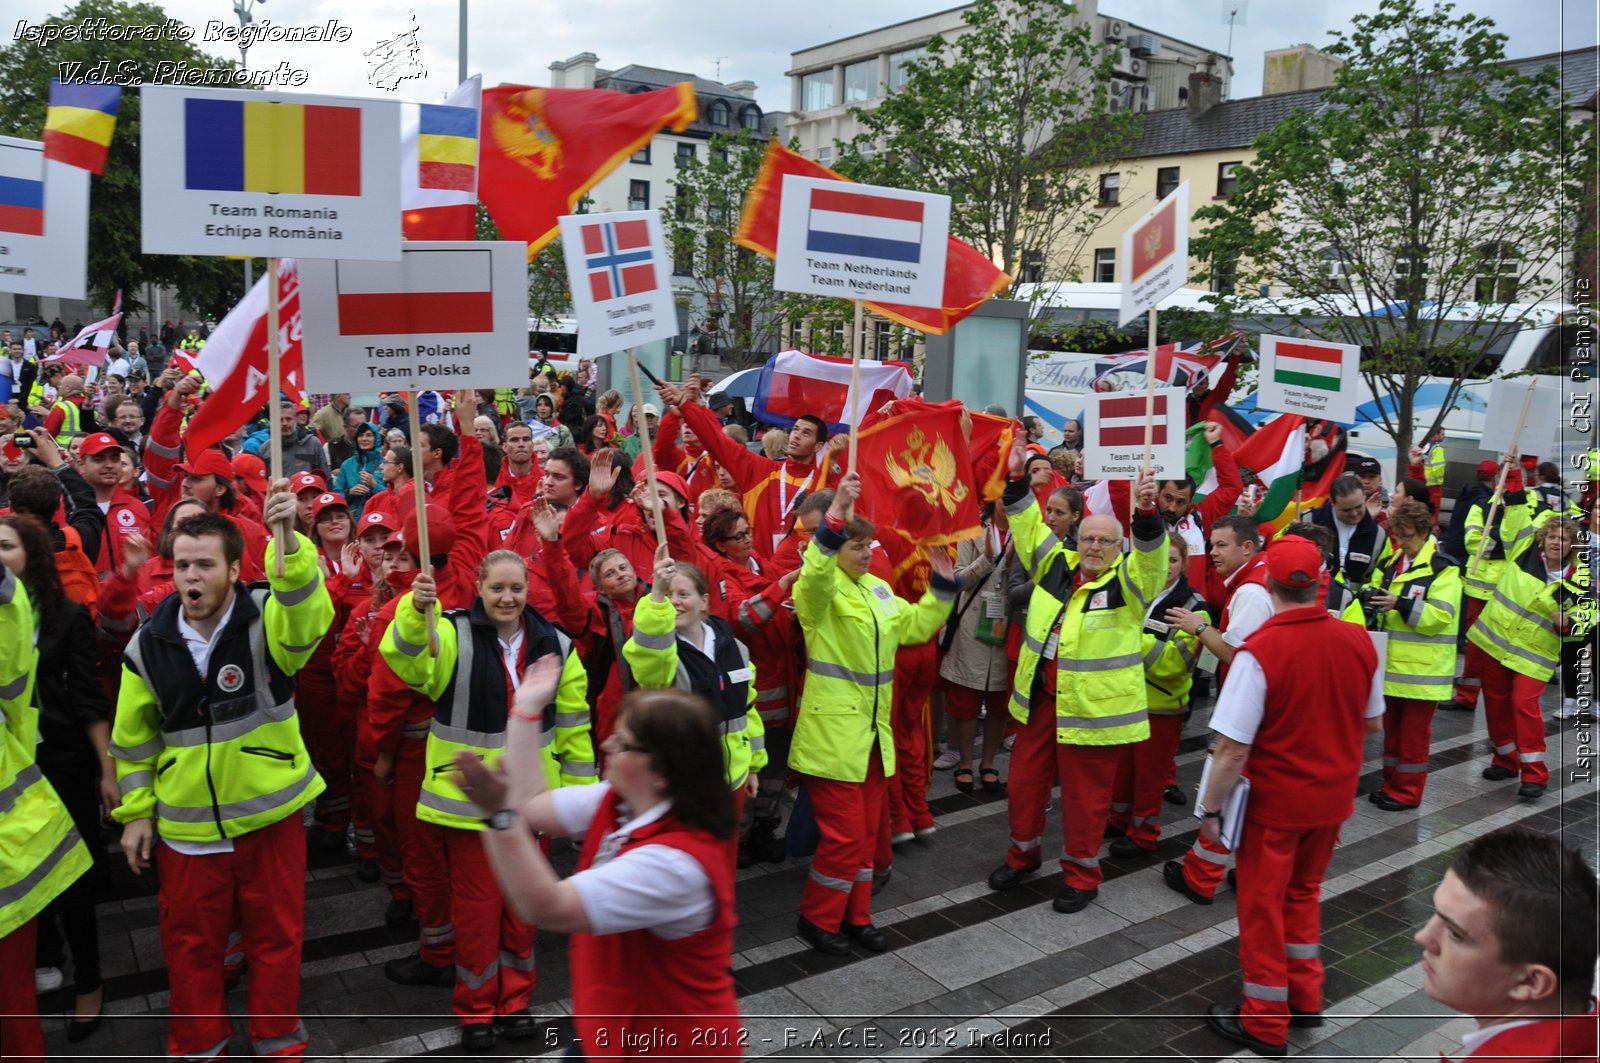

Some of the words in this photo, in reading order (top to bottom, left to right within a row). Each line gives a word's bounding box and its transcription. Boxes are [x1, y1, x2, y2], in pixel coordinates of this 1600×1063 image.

[209, 203, 257, 217] Team
[263, 205, 339, 220] Romania
[205, 224, 263, 240] Echipa
[268, 226, 343, 240] România
[806, 257, 840, 271] Team
[843, 262, 918, 280] Netherlands
[811, 273, 845, 287] Team
[848, 278, 911, 294] Nederland
[364, 346, 411, 358] Team
[416, 343, 471, 356] Poland
[367, 366, 412, 378] Team
[418, 364, 471, 376] Polska
[1284, 389, 1302, 397] Team
[1101, 464, 1136, 472] Komanda
